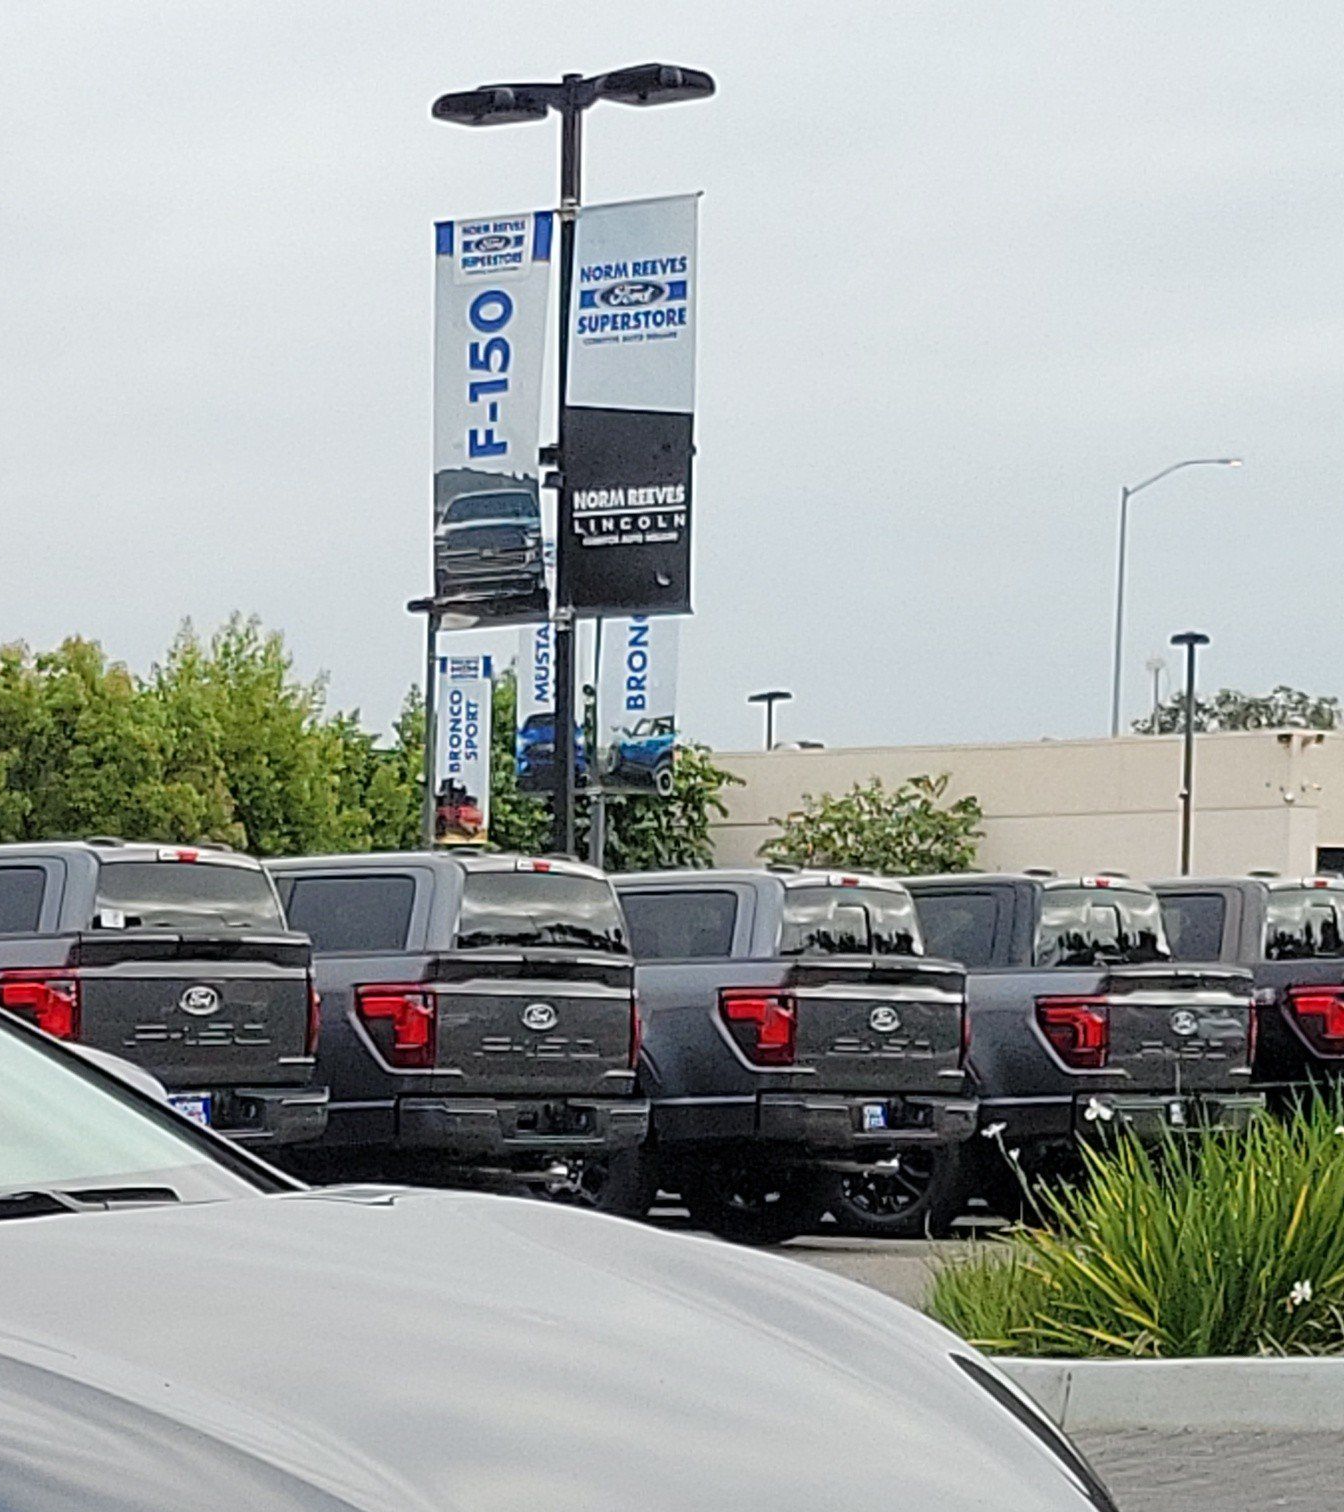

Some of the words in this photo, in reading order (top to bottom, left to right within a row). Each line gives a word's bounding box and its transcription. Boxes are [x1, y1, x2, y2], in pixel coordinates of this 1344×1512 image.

[580, 262, 628, 283] NORM
[632, 256, 687, 277] REEVES
[577, 307, 687, 334] SUPERSTORE
[469, 289, 513, 457] F-150
[574, 488, 625, 510] NORM
[627, 484, 686, 506] REEVES
[574, 513, 686, 534] LINCOLN
[449, 690, 462, 772] BRONCO
[465, 700, 479, 760] SPORT
